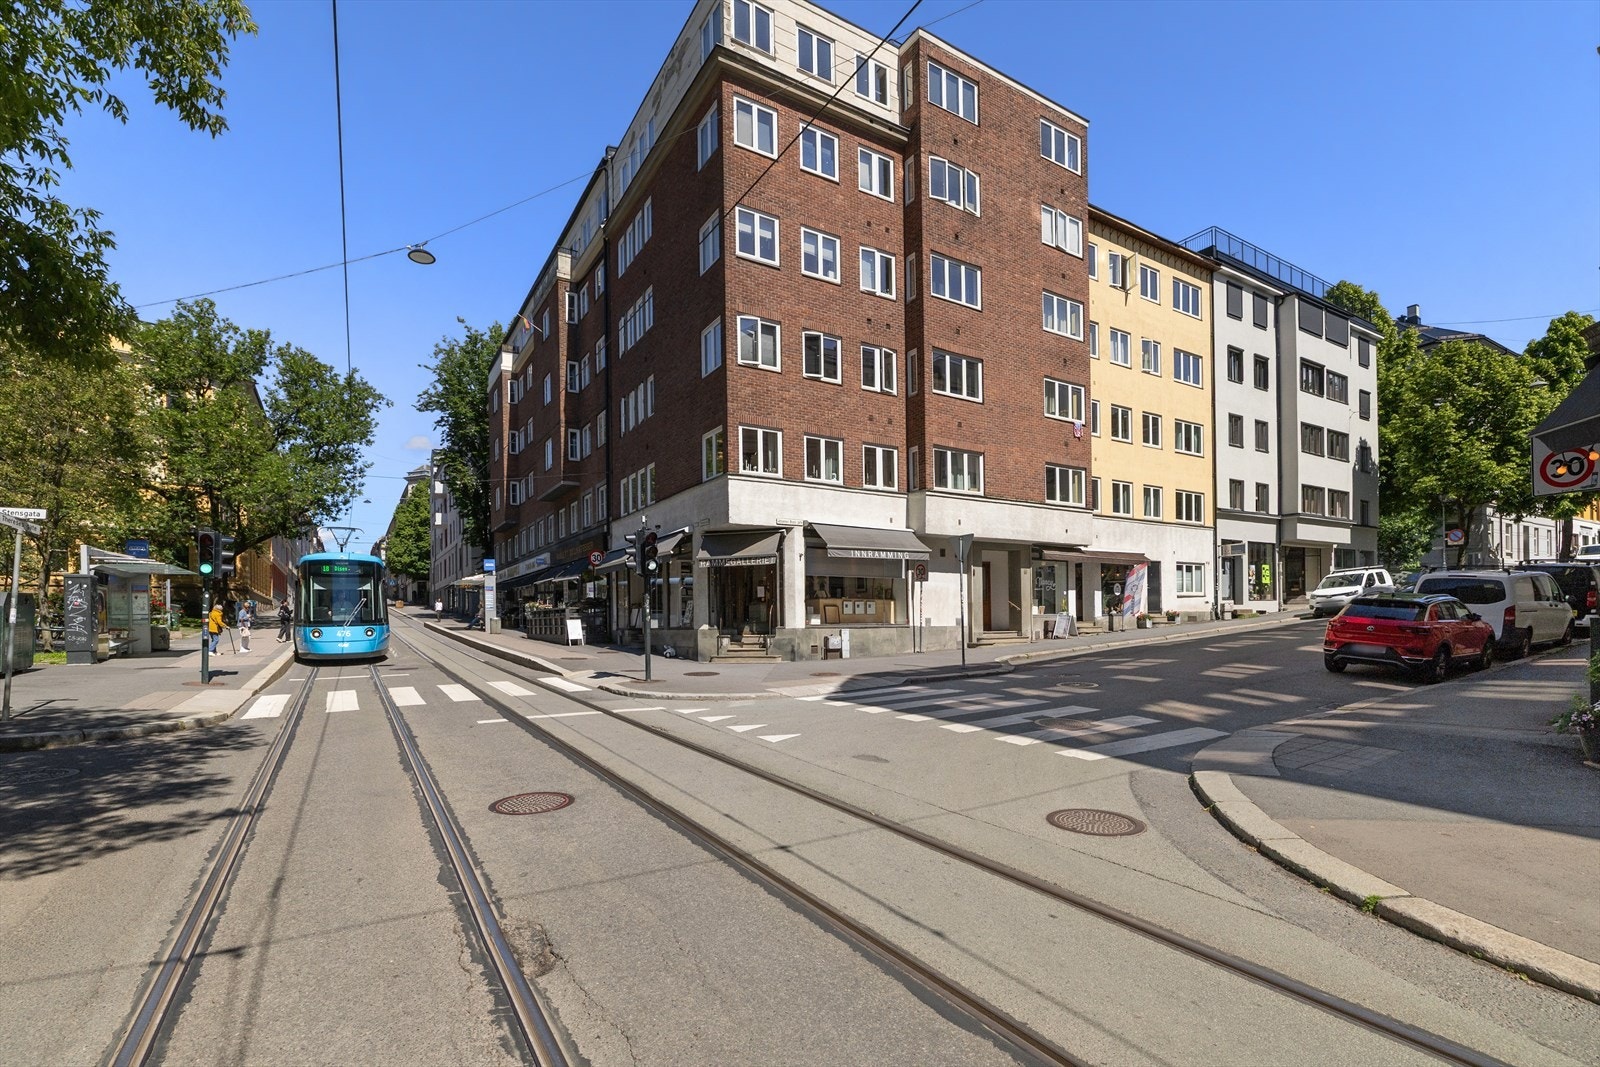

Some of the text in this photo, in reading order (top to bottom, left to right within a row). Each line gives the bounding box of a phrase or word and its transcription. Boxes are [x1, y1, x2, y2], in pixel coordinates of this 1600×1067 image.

[1551, 456, 1585, 478] 30
[1, 509, 41, 518] Stensgata
[591, 554, 602, 562] 30
[850, 550, 910, 559] INNRAMMING
[336, 630, 351, 638] 476
